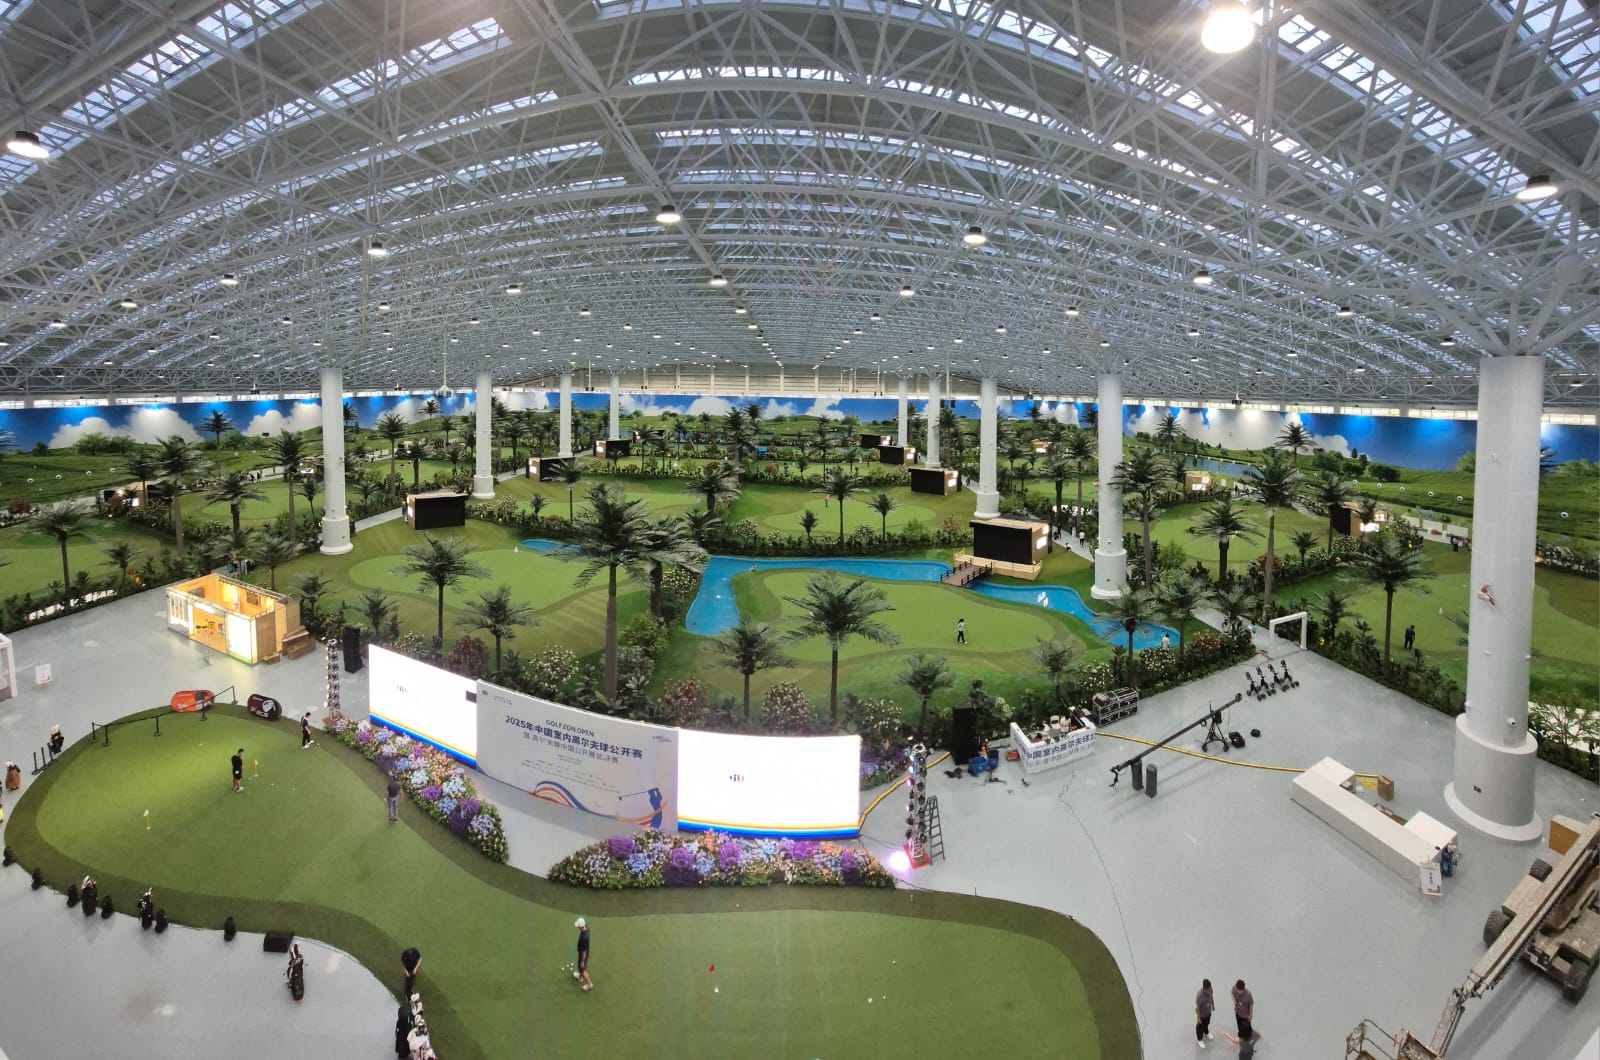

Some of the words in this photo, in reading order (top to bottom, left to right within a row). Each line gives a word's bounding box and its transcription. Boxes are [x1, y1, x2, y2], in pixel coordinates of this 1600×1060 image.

[505, 715, 643, 759] 2025年中国室内高尔夫球公开赛
[545, 719, 576, 733] GOLFZON
[576, 727, 595, 738] OPEN
